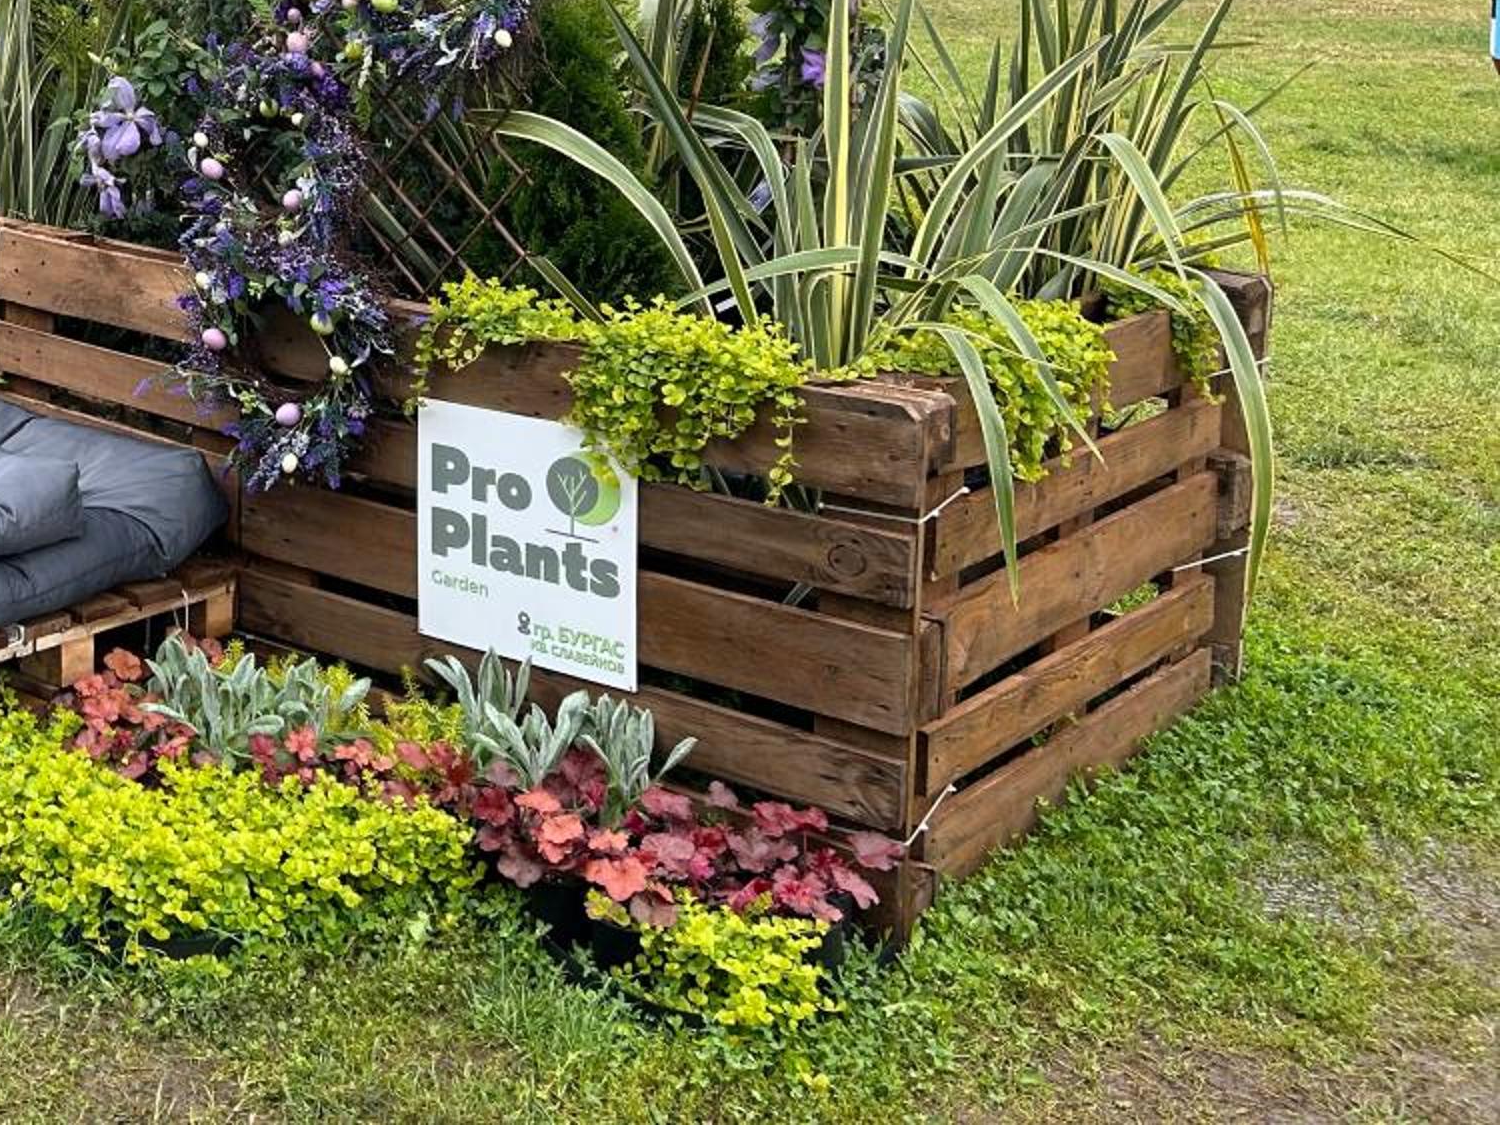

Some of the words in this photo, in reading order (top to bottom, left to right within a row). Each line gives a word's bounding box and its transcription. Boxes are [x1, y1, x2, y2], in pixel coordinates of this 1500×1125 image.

[431, 442, 532, 511] Pro
[431, 506, 620, 598] Plants
[431, 570, 489, 598] Garden
[558, 626, 625, 659] БУРГАС
